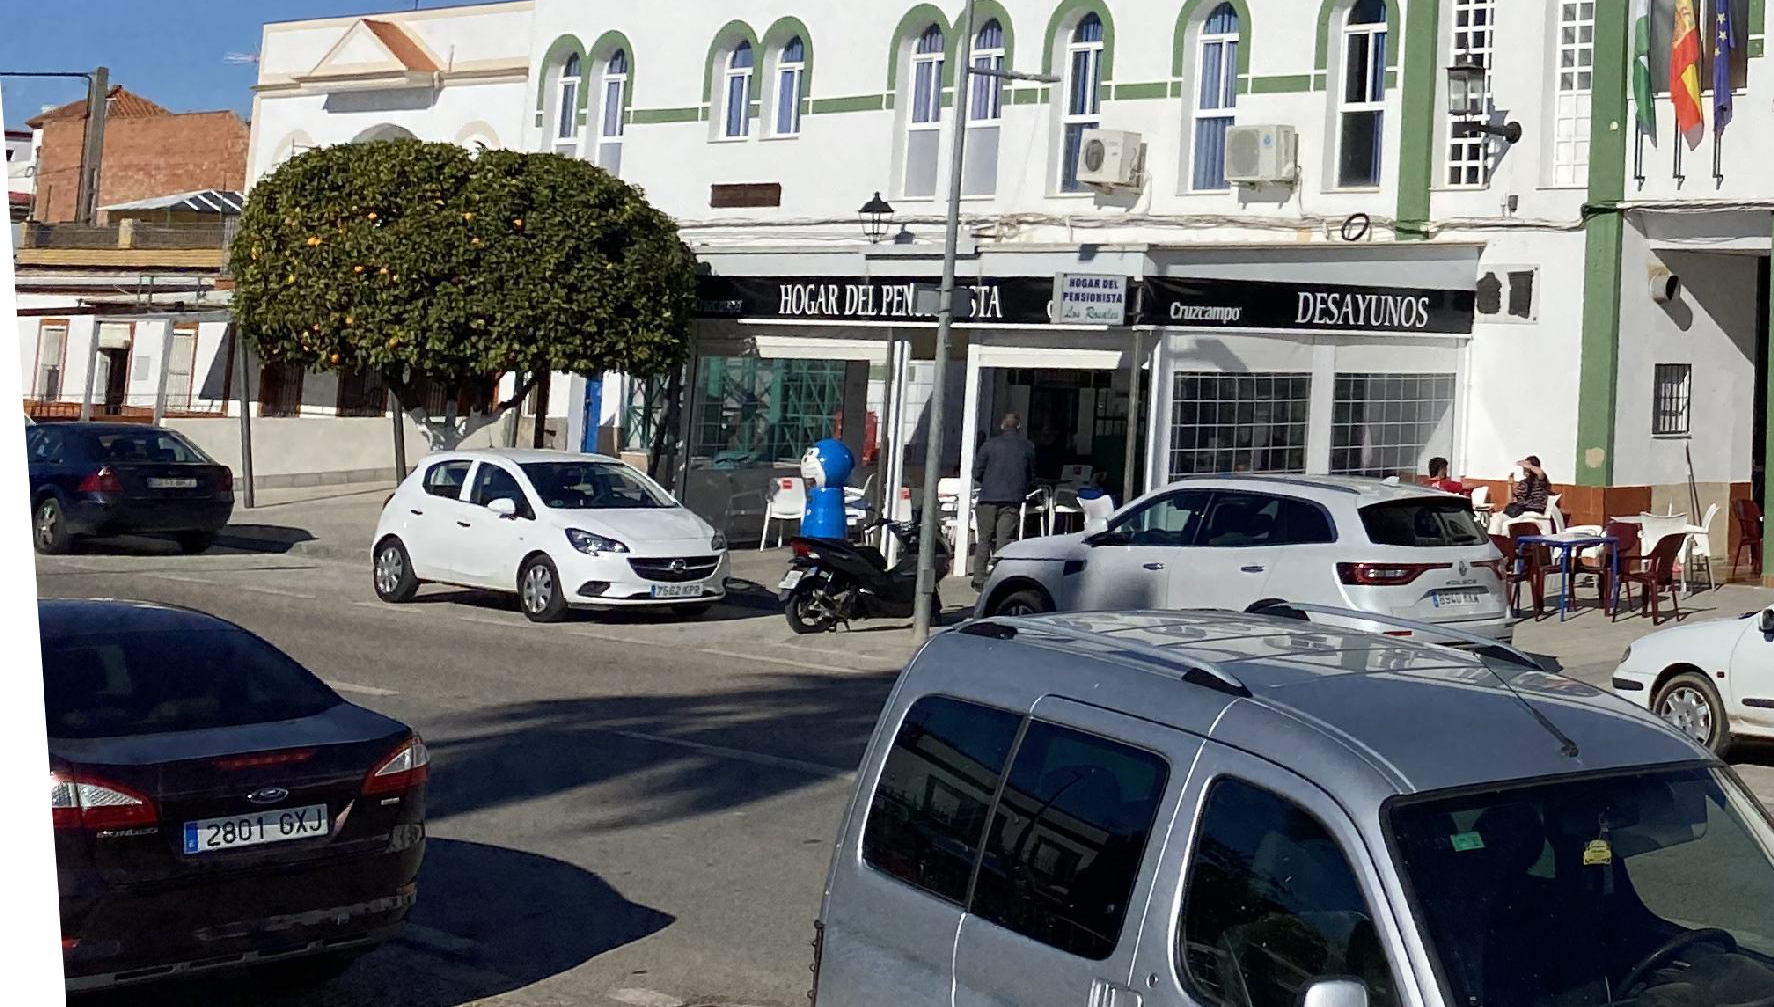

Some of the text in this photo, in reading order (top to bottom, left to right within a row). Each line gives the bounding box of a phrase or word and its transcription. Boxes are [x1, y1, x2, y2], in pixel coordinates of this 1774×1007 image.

[1063, 292, 1122, 304] PENSIONISTA
[1070, 278, 1119, 290] HOGAR DEL
[778, 283, 840, 315] HOGAR
[844, 284, 877, 316] DEL
[1169, 301, 1241, 325] Cruzcampo
[1295, 291, 1430, 329] DESAYUNOS
[206, 808, 322, 847] 2801 GXJ
